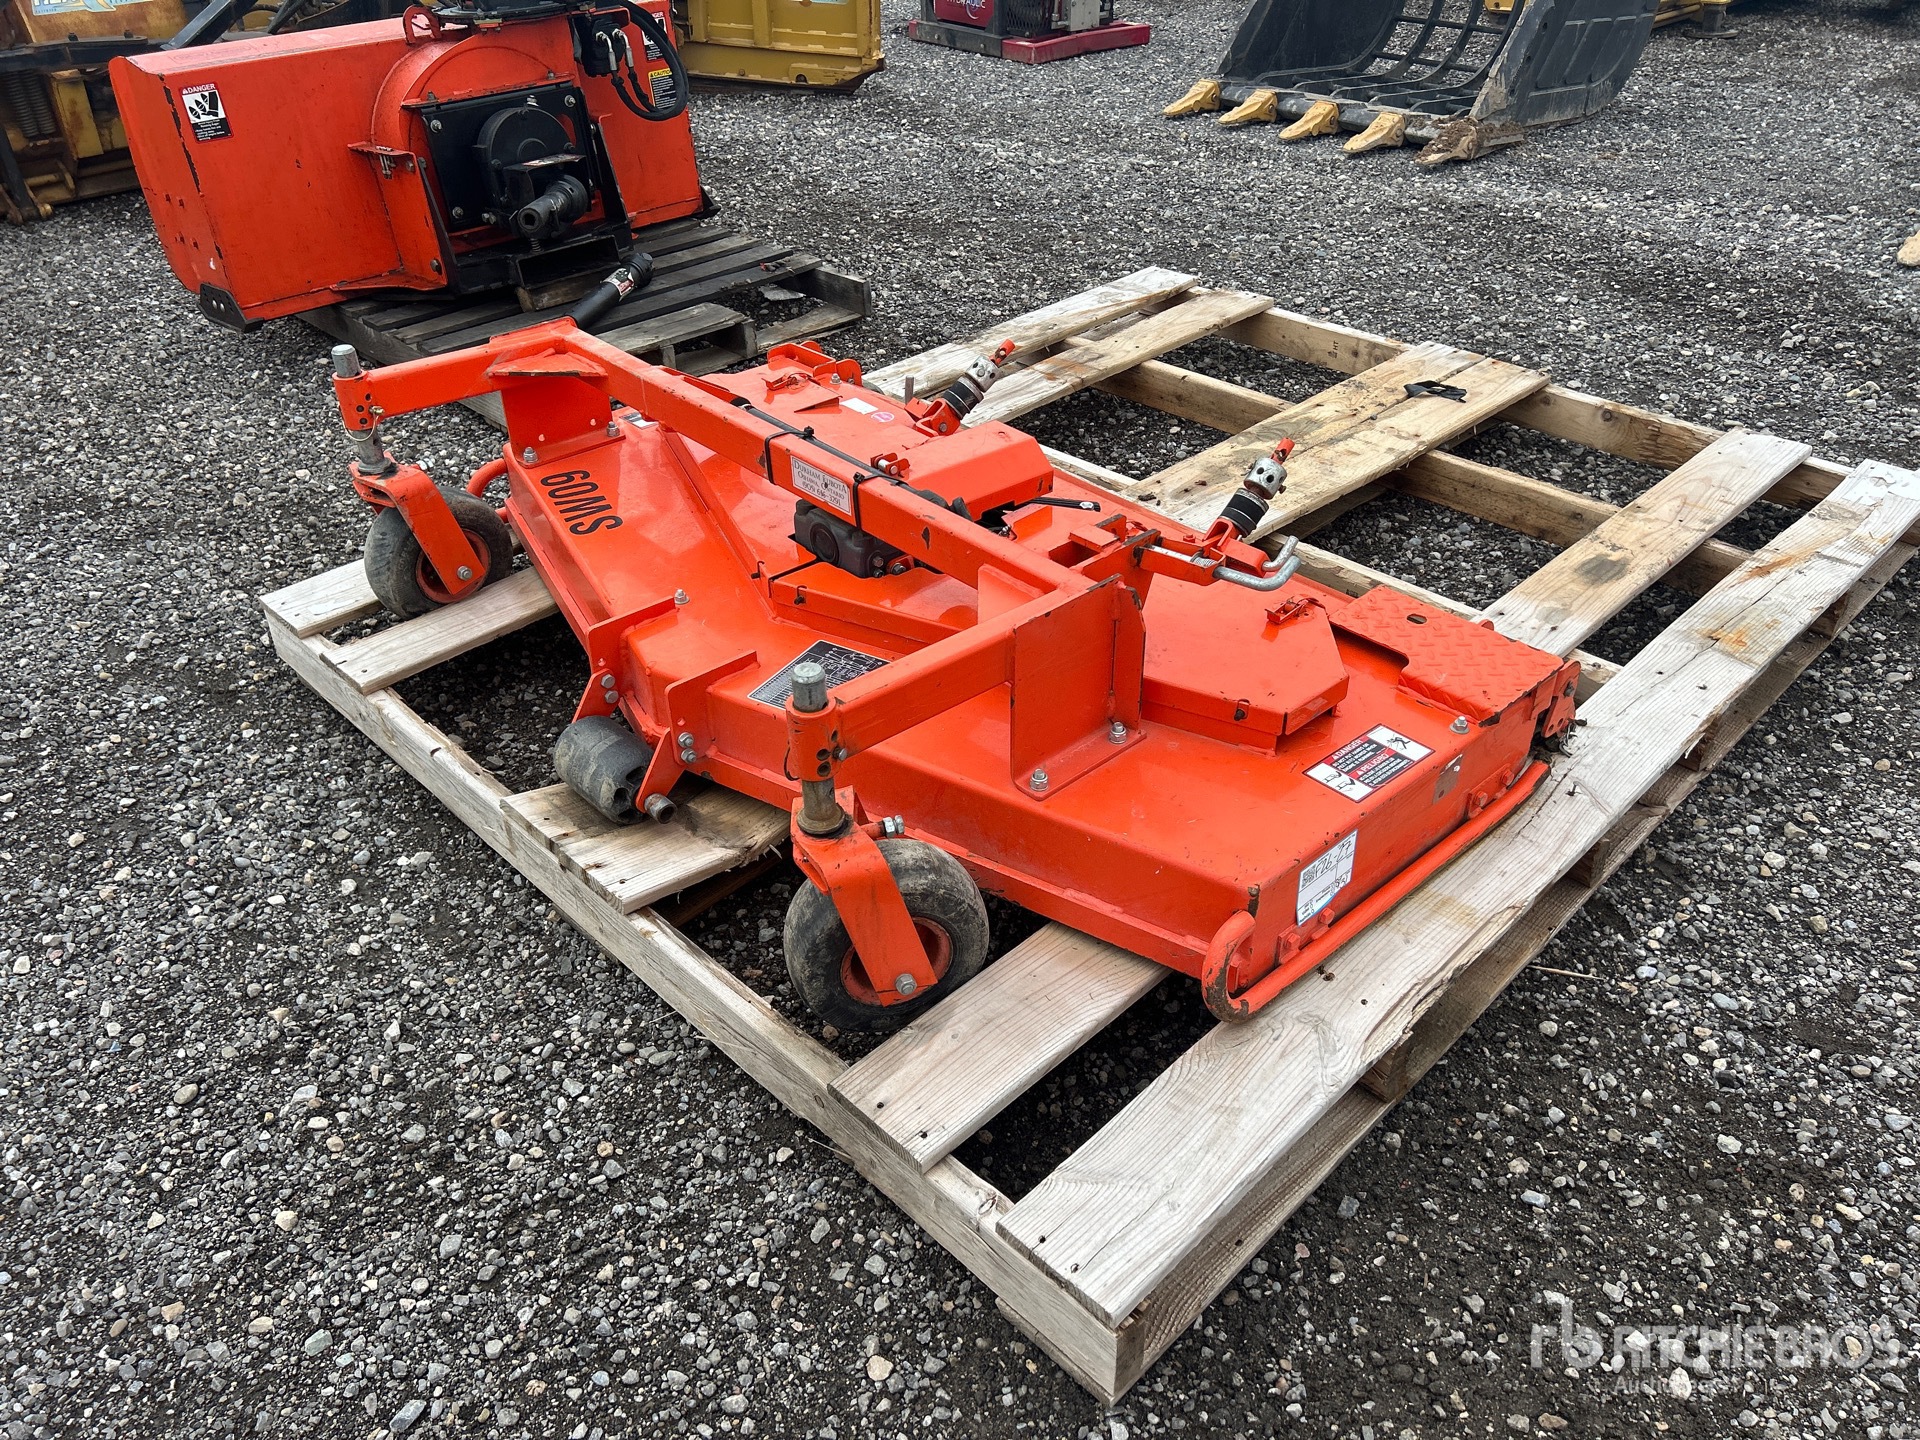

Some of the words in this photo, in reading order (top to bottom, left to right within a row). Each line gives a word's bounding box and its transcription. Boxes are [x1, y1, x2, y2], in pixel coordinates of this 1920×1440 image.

[187, 83, 216, 94] DANGER
[540, 470, 624, 535] 60MS
[1336, 739, 1363, 759] DANGER
[1361, 753, 1390, 774] PELIGRO
